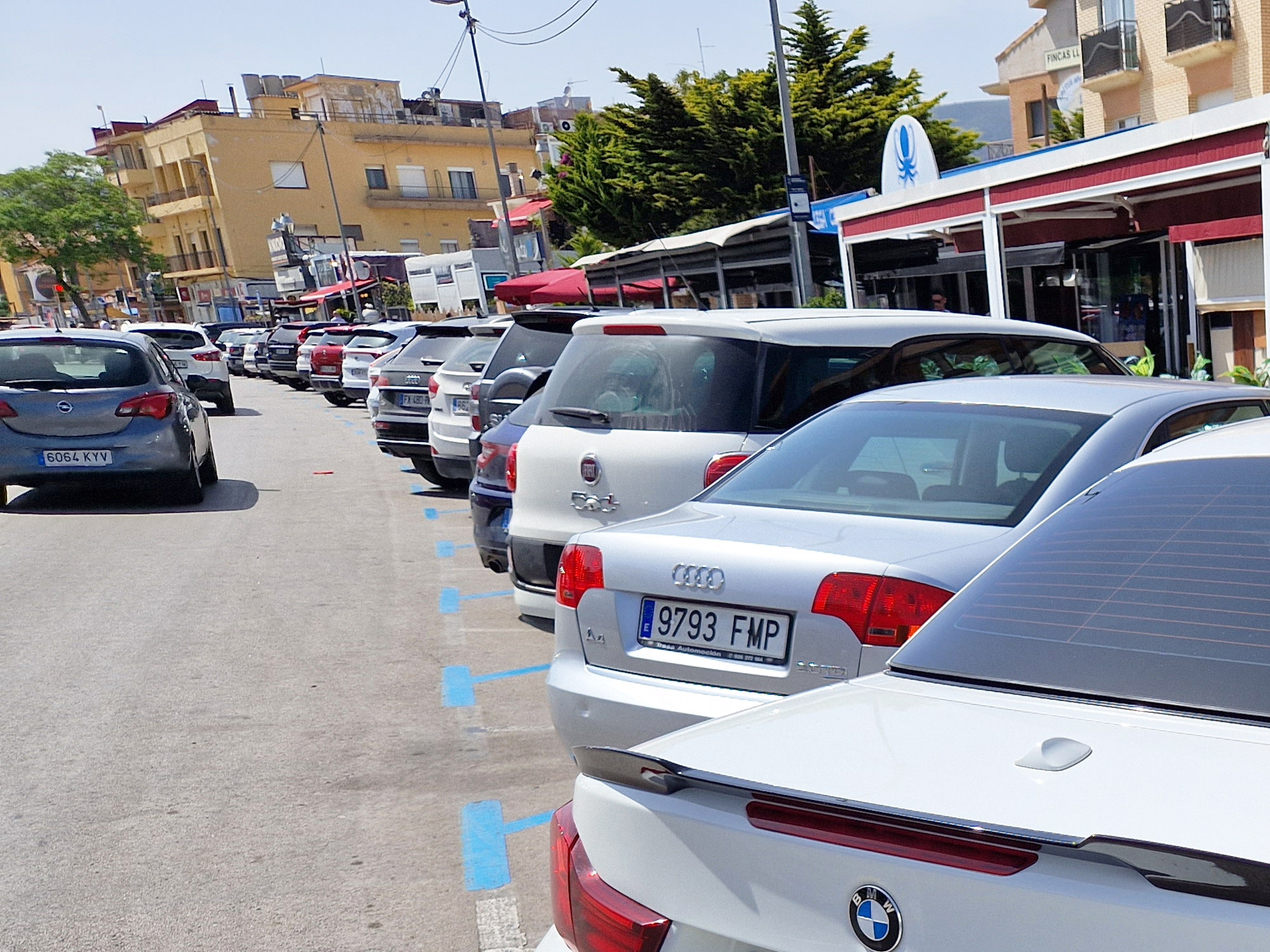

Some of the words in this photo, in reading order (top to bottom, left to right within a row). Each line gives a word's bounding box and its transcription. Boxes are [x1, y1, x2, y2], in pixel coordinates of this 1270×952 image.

[1047, 50, 1070, 63] FINCAS
[46, 452, 80, 463] 6064
[83, 451, 108, 462] KYV
[586, 627, 605, 644] A4
[658, 605, 718, 642] 9793
[730, 614, 781, 651] FMP
[677, 645, 722, 658] Automoción
[852, 887, 896, 914] BMW
